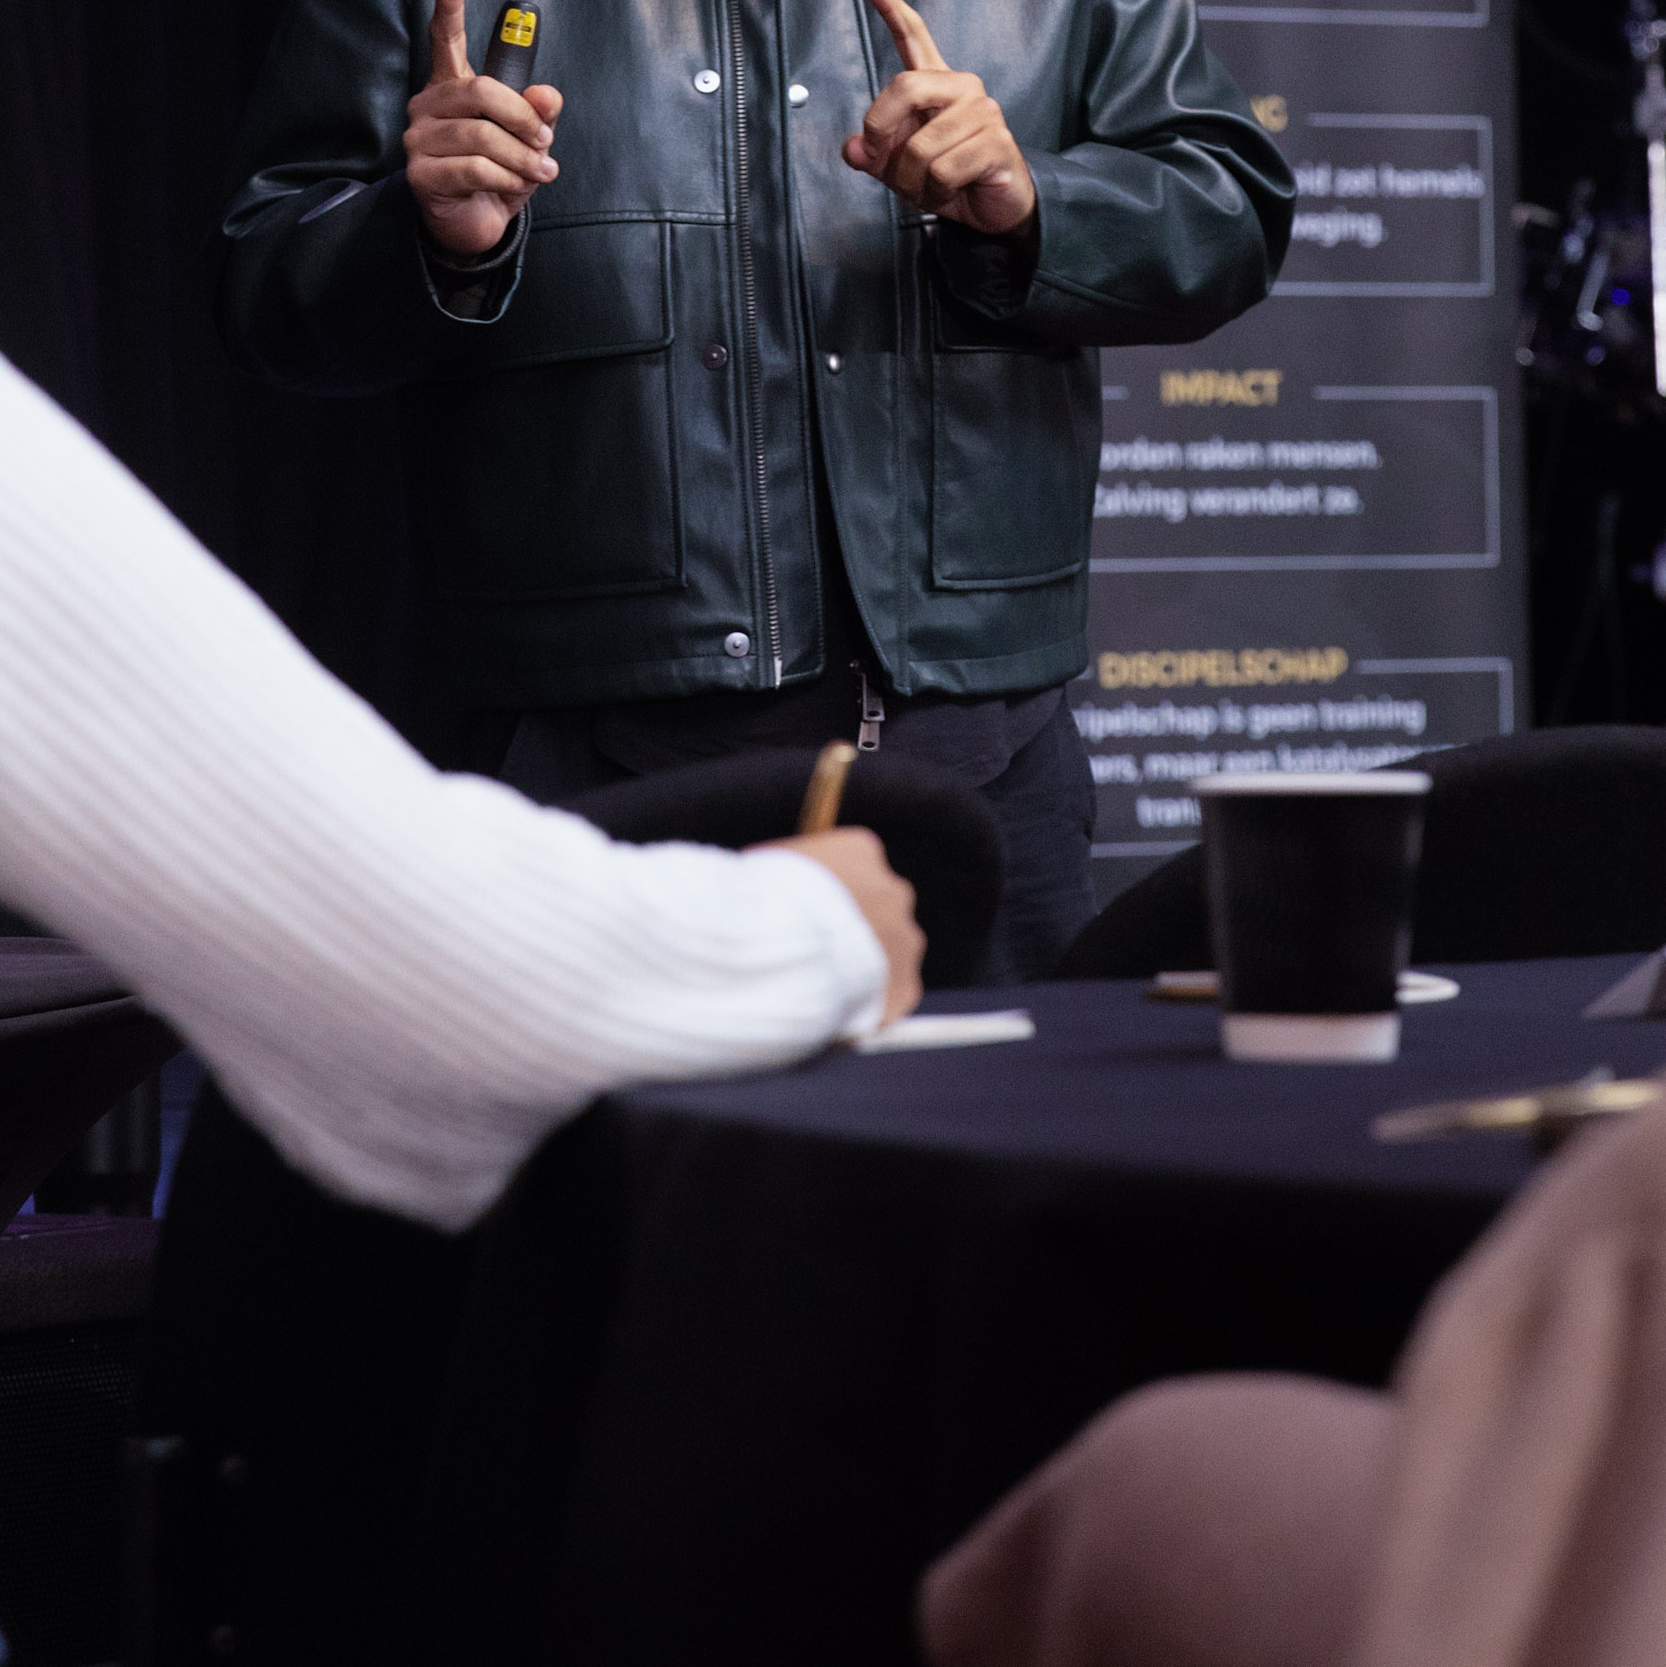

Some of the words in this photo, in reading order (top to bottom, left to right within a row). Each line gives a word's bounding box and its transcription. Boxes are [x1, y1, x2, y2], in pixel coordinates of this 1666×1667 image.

[1159, 368, 1281, 407] IMPACT
[1099, 436, 1183, 471] orden
[1183, 435, 1265, 470] raken
[1189, 479, 1320, 516] verandert
[1098, 646, 1349, 690] DISCIPELSCHAP
[1218, 698, 1246, 734] is
[1246, 702, 1318, 740] geen
[1319, 694, 1427, 736] training
